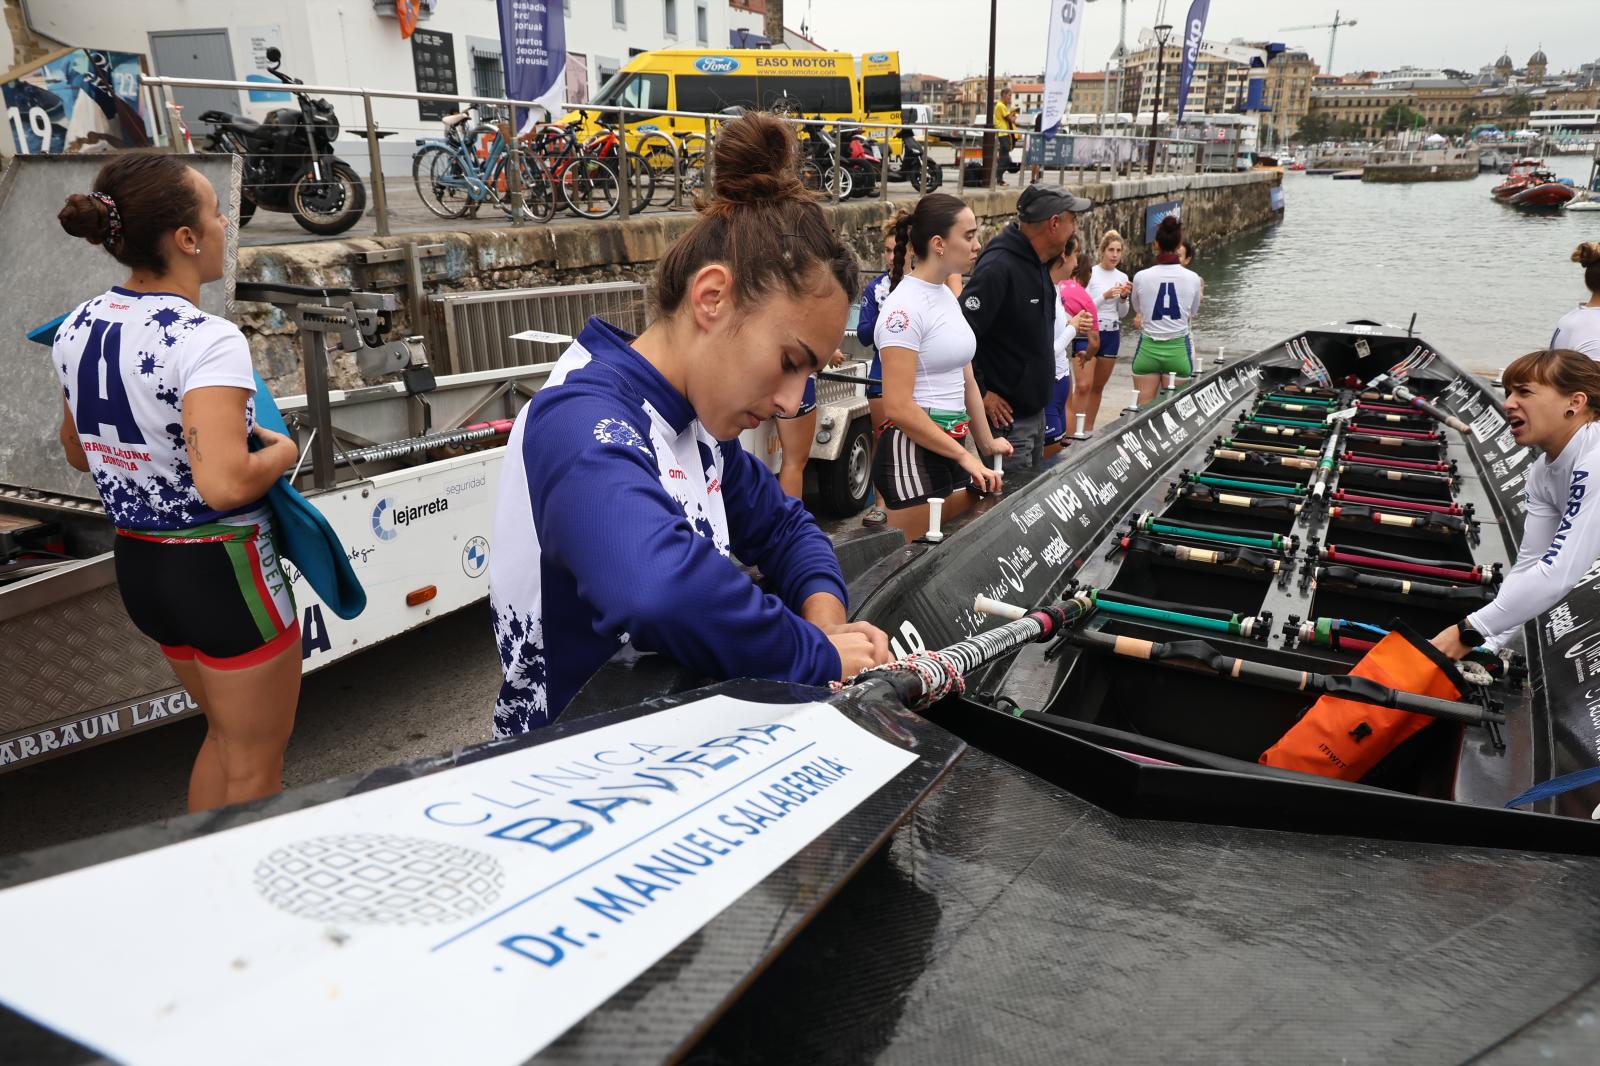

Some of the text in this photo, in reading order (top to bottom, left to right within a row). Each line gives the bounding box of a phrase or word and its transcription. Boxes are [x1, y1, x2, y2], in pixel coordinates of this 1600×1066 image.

[702, 57, 732, 71] Ford
[756, 58, 836, 67] EASO MOTOR
[8, 106, 52, 155] 19
[1151, 282, 1181, 321] A
[76, 318, 147, 445] A
[446, 475, 487, 495] seguridad
[393, 498, 449, 527] lejarreta
[1540, 470, 1590, 566] ARRAUN
[0, 712, 120, 766] ARRAUN
[1318, 743, 1346, 769] ITIWIT
[424, 739, 678, 829] CLINICA
[486, 723, 796, 853] BAVIERA
[497, 757, 852, 968] Dr. MANUEL SALABERRIA
